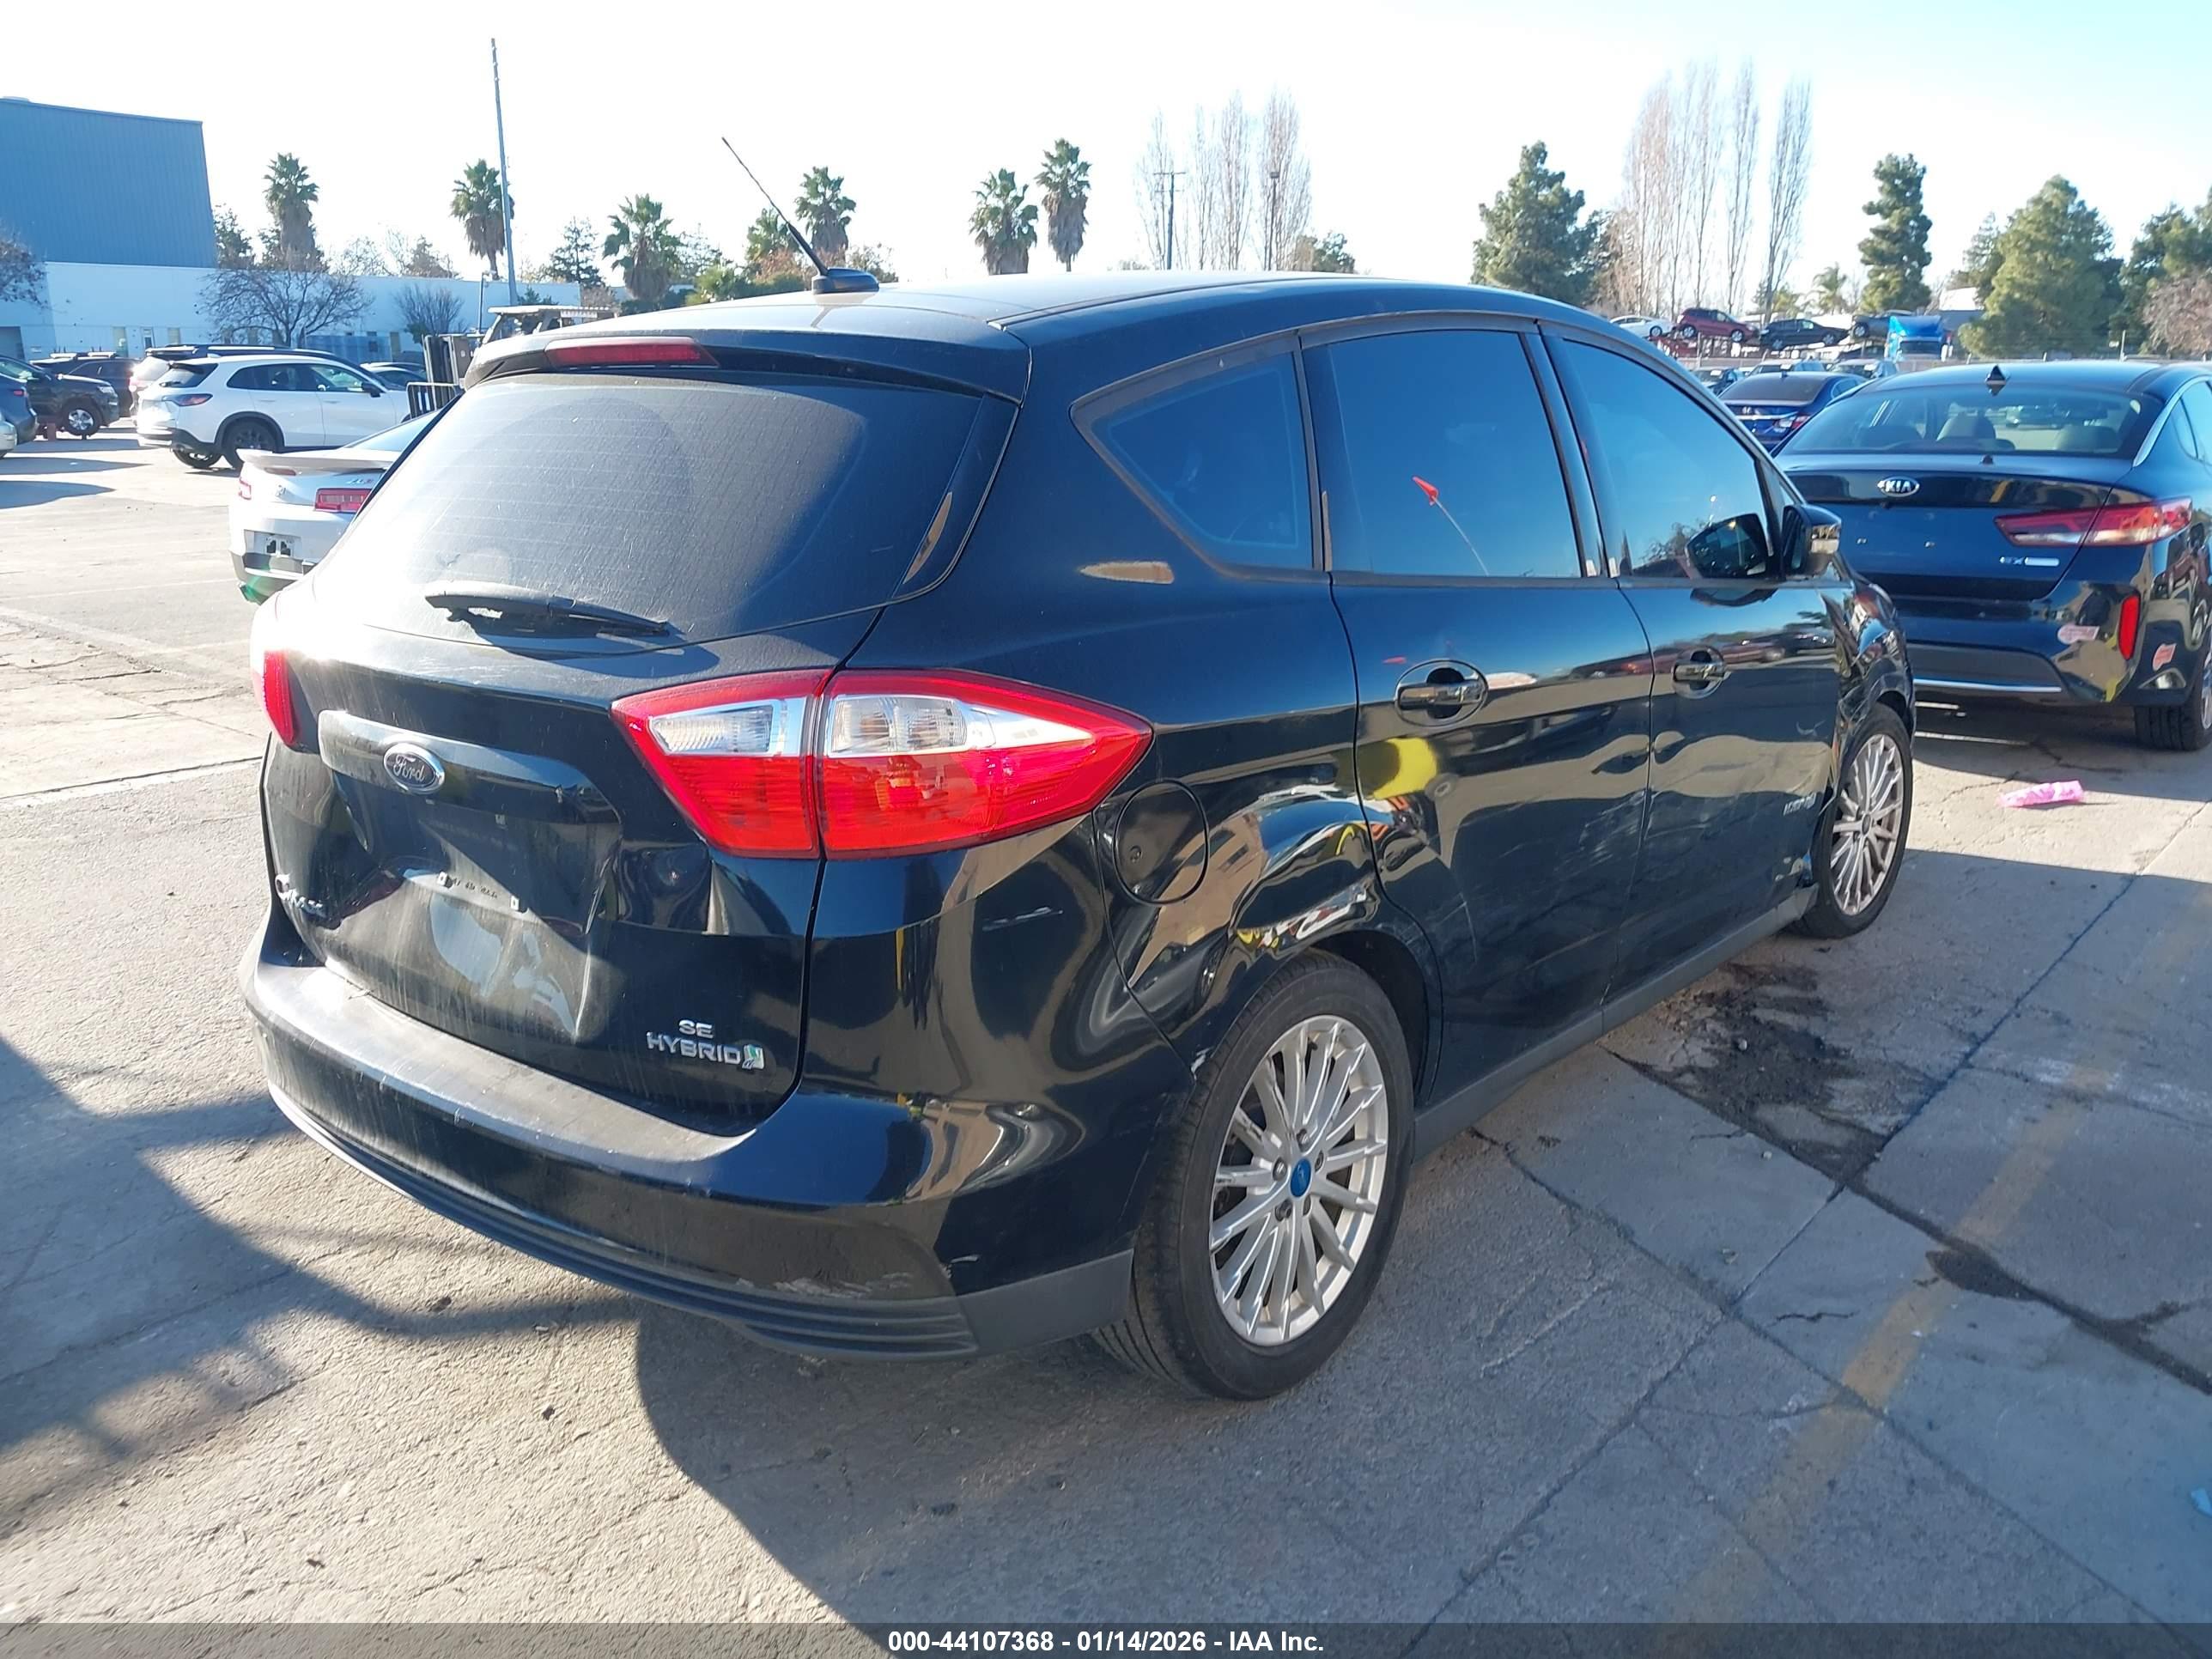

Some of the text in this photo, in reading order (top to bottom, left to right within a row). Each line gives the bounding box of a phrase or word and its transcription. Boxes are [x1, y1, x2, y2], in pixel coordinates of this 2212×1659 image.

[1885, 480, 1912, 493] KIA
[392, 754, 426, 783] Ford
[678, 1019, 714, 1039] SE
[646, 1031, 741, 1065] HYBRID
